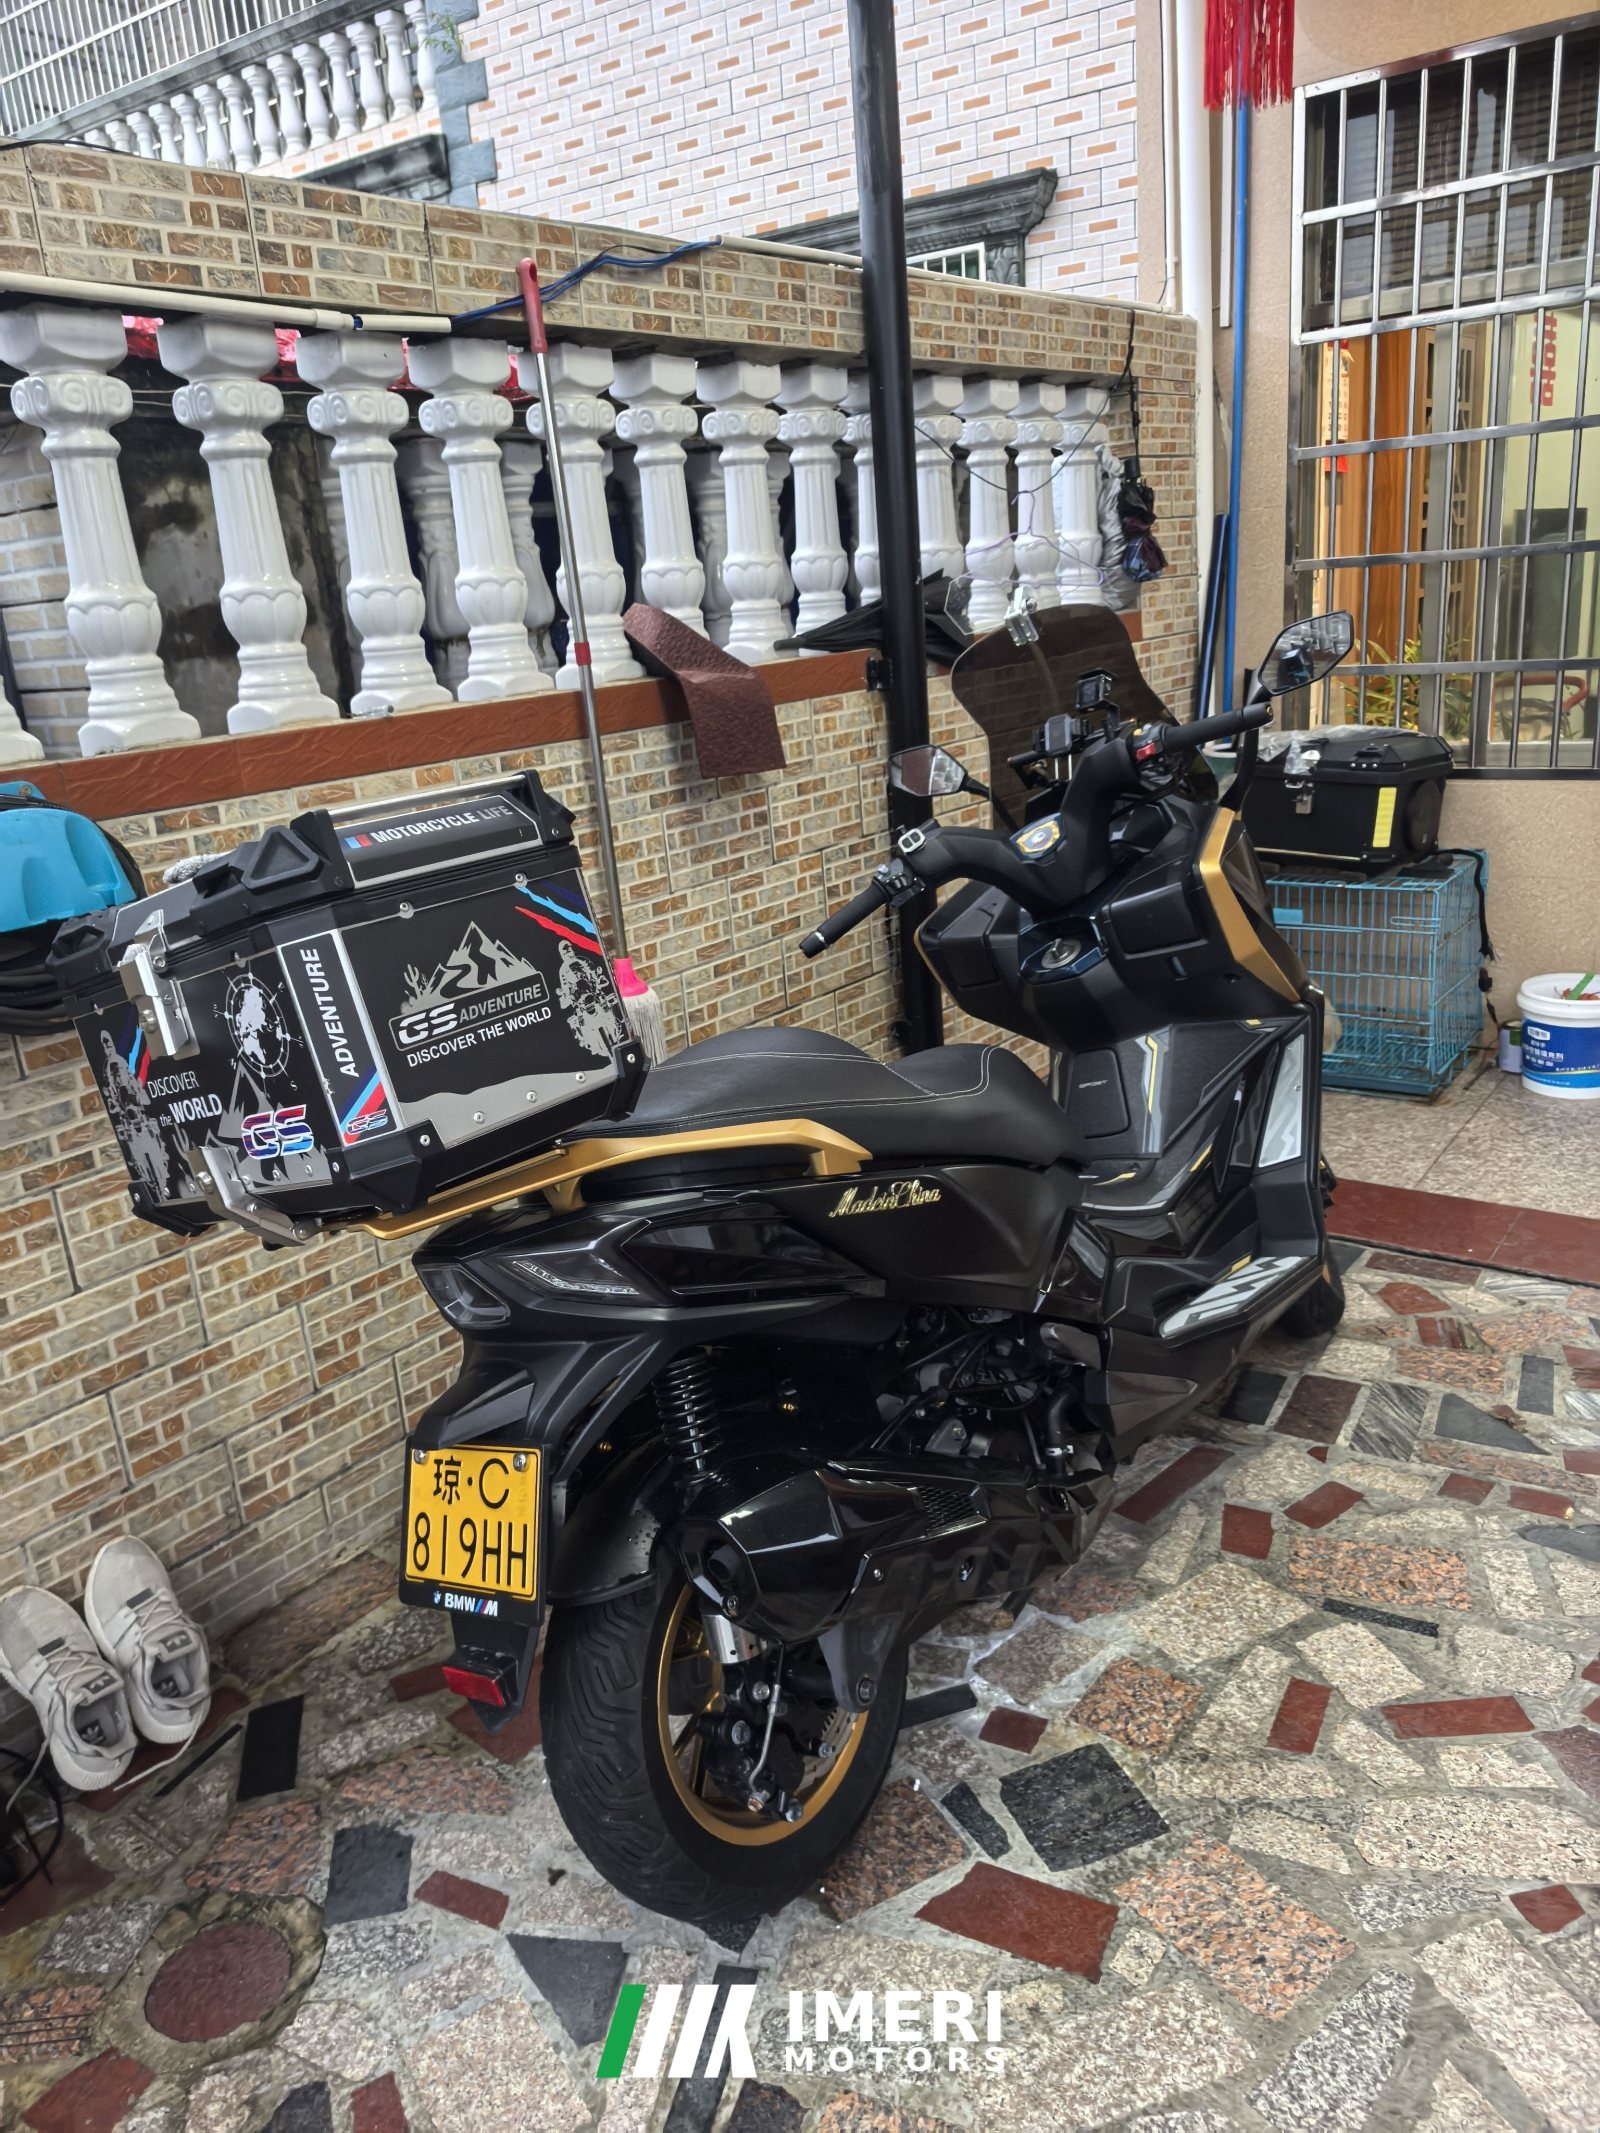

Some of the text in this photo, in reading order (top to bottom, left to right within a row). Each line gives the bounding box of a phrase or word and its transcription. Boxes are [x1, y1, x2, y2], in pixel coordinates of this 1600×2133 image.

[370, 805, 514, 843] MOTORCYCLE LIFE
[300, 948, 360, 1078] ADVENTURE
[398, 983, 543, 1045] GS ADVENTURE
[407, 1006, 552, 1068] DISCOVER THE WORLD
[147, 1070, 200, 1099] DISCOVER
[160, 1093, 223, 1127] the WORLD
[240, 1104, 314, 1161] GS
[346, 1108, 389, 1136] GS
[413, 1511, 528, 1589] 819HH
